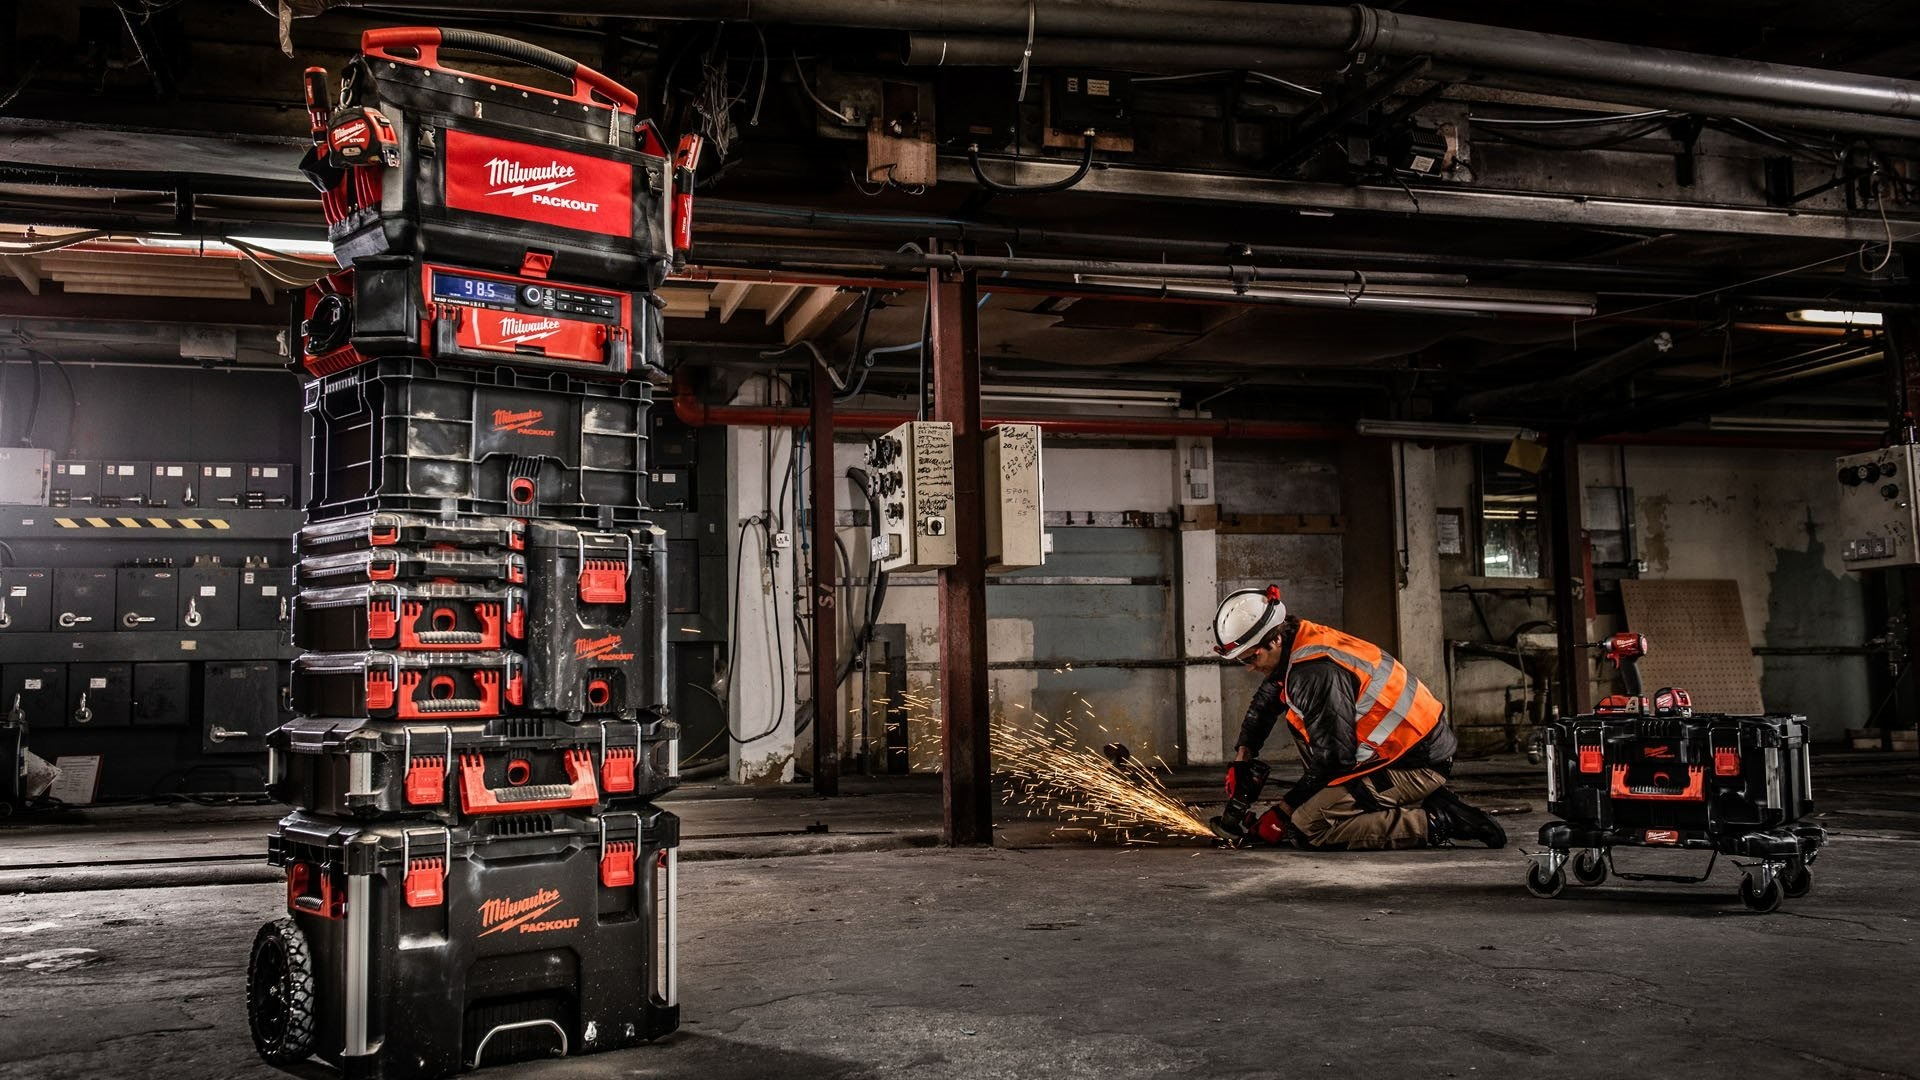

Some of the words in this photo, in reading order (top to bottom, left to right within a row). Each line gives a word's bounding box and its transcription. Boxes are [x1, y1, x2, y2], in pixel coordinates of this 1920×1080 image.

[483, 157, 576, 187] Milwaukee
[532, 194, 599, 213] PACKOUT
[498, 317, 560, 337] Milwaukee
[492, 408, 543, 426] Milwaukee
[517, 428, 556, 436] PACKOUT
[573, 634, 621, 655] Milwaukee
[477, 888, 560, 928] Milwaukee
[520, 918, 580, 934] PACKOUT
